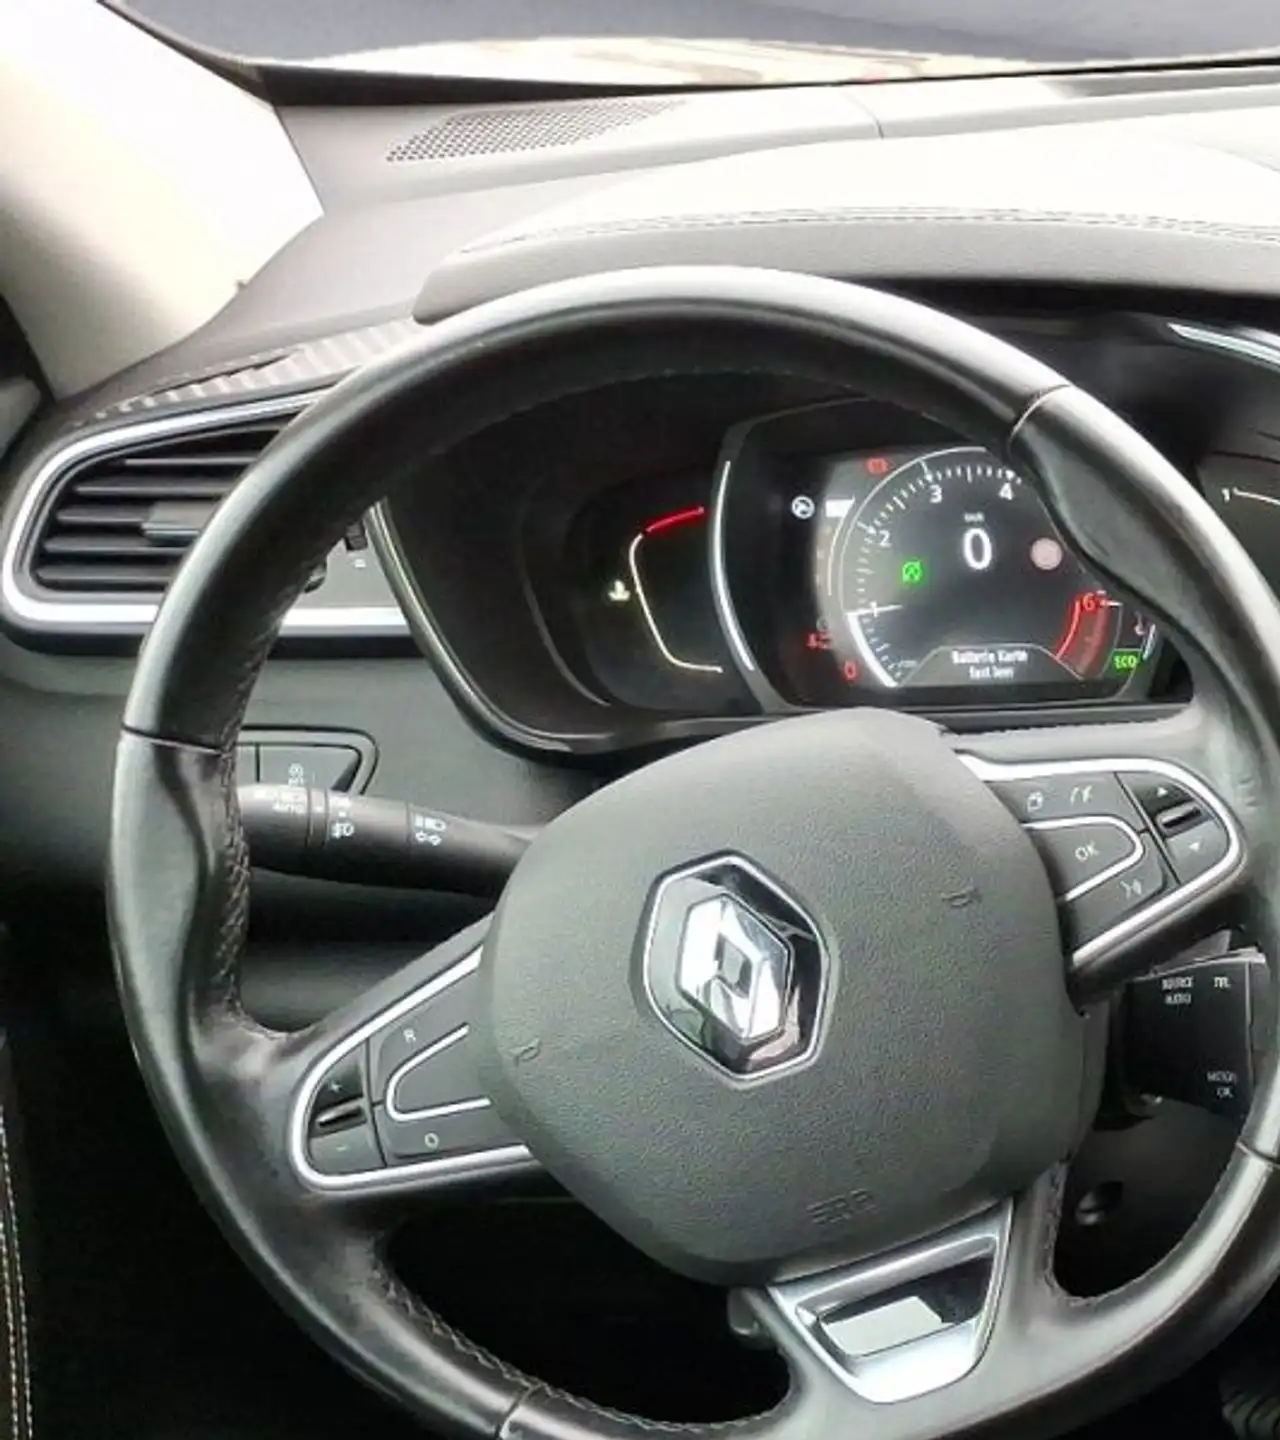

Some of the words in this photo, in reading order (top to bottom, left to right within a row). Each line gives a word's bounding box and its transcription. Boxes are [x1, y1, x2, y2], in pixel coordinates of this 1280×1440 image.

[929, 484, 942, 503] 3
[998, 482, 1013, 500] 4
[963, 527, 993, 570] 0
[1113, 655, 1137, 669] ECO
[1075, 842, 1099, 861] OK
